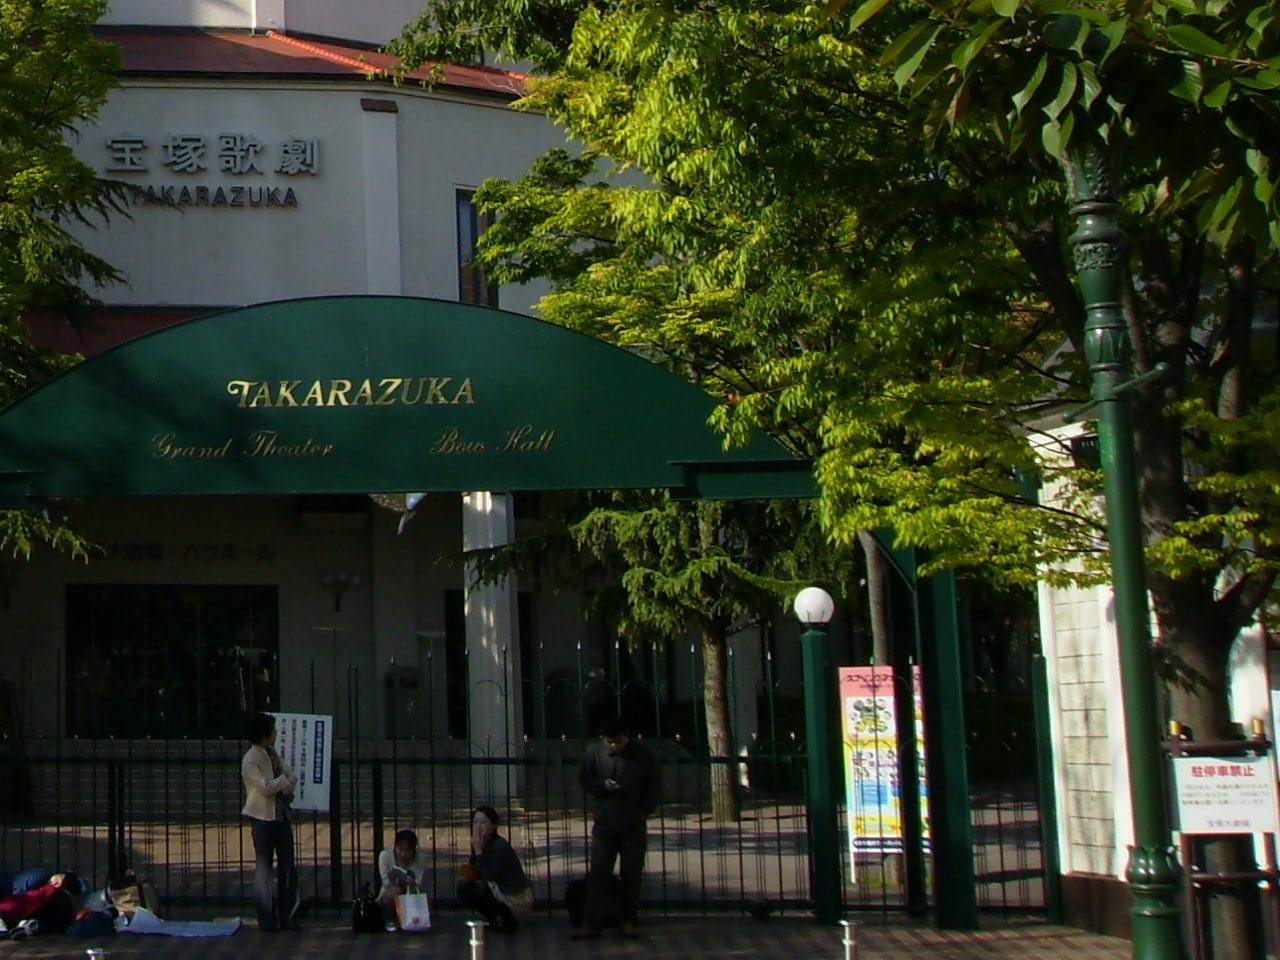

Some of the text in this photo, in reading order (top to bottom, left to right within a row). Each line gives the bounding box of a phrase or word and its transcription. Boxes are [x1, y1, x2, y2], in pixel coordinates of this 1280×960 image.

[105, 132, 321, 176] 宝塚歌劇
[227, 377, 476, 408] TAKARAZUKA
[151, 424, 557, 459] Grand Theater Bow Hall
[1191, 765, 1255, 777] 駐停車禁止
